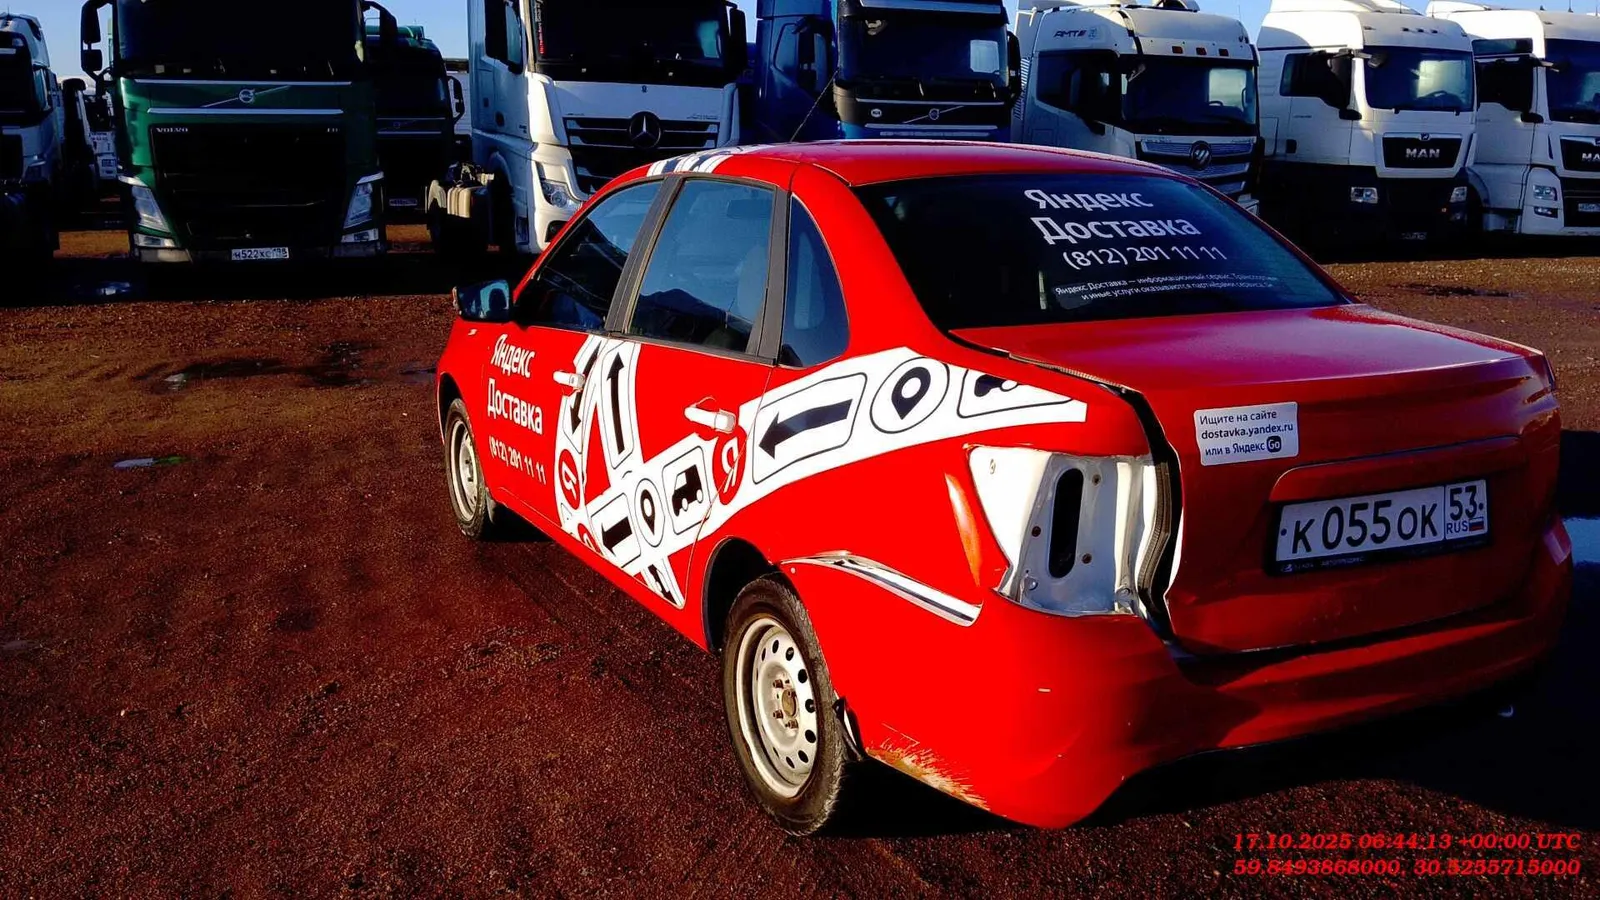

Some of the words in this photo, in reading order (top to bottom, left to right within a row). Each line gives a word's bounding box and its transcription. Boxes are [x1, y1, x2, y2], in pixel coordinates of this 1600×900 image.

[1405, 148, 1440, 158] MAN
[1582, 153, 1600, 161] MA
[1024, 189, 1154, 212] Яндекс
[1030, 217, 1201, 245] Доставка
[1062, 248, 1128, 270] (812)
[1127, 247, 1171, 262] 201
[1171, 246, 1200, 260] 11
[1200, 246, 1228, 260] 11
[1055, 284, 1088, 295] Яндекс
[1087, 280, 1128, 291] Доставка
[1089, 291, 1113, 299] иные
[1111, 287, 1141, 297] услуги
[490, 333, 536, 379] Яндекс
[487, 377, 544, 436] Доставка
[1200, 415, 1234, 426] Ищите
[1236, 413, 1248, 422] на
[1250, 410, 1277, 421] сайте
[1201, 423, 1294, 440] dostavka.yandex.ru
[1205, 447, 1223, 456] или
[1225, 446, 1231, 454] в
[1232, 442, 1265, 454] Яндекс
[488, 435, 509, 467] (812)
[508, 446, 523, 471] 201
[524, 455, 535, 478] 11
[536, 462, 547, 485] 11
[1449, 485, 1478, 521] 53
[1446, 520, 1469, 534] RUS
